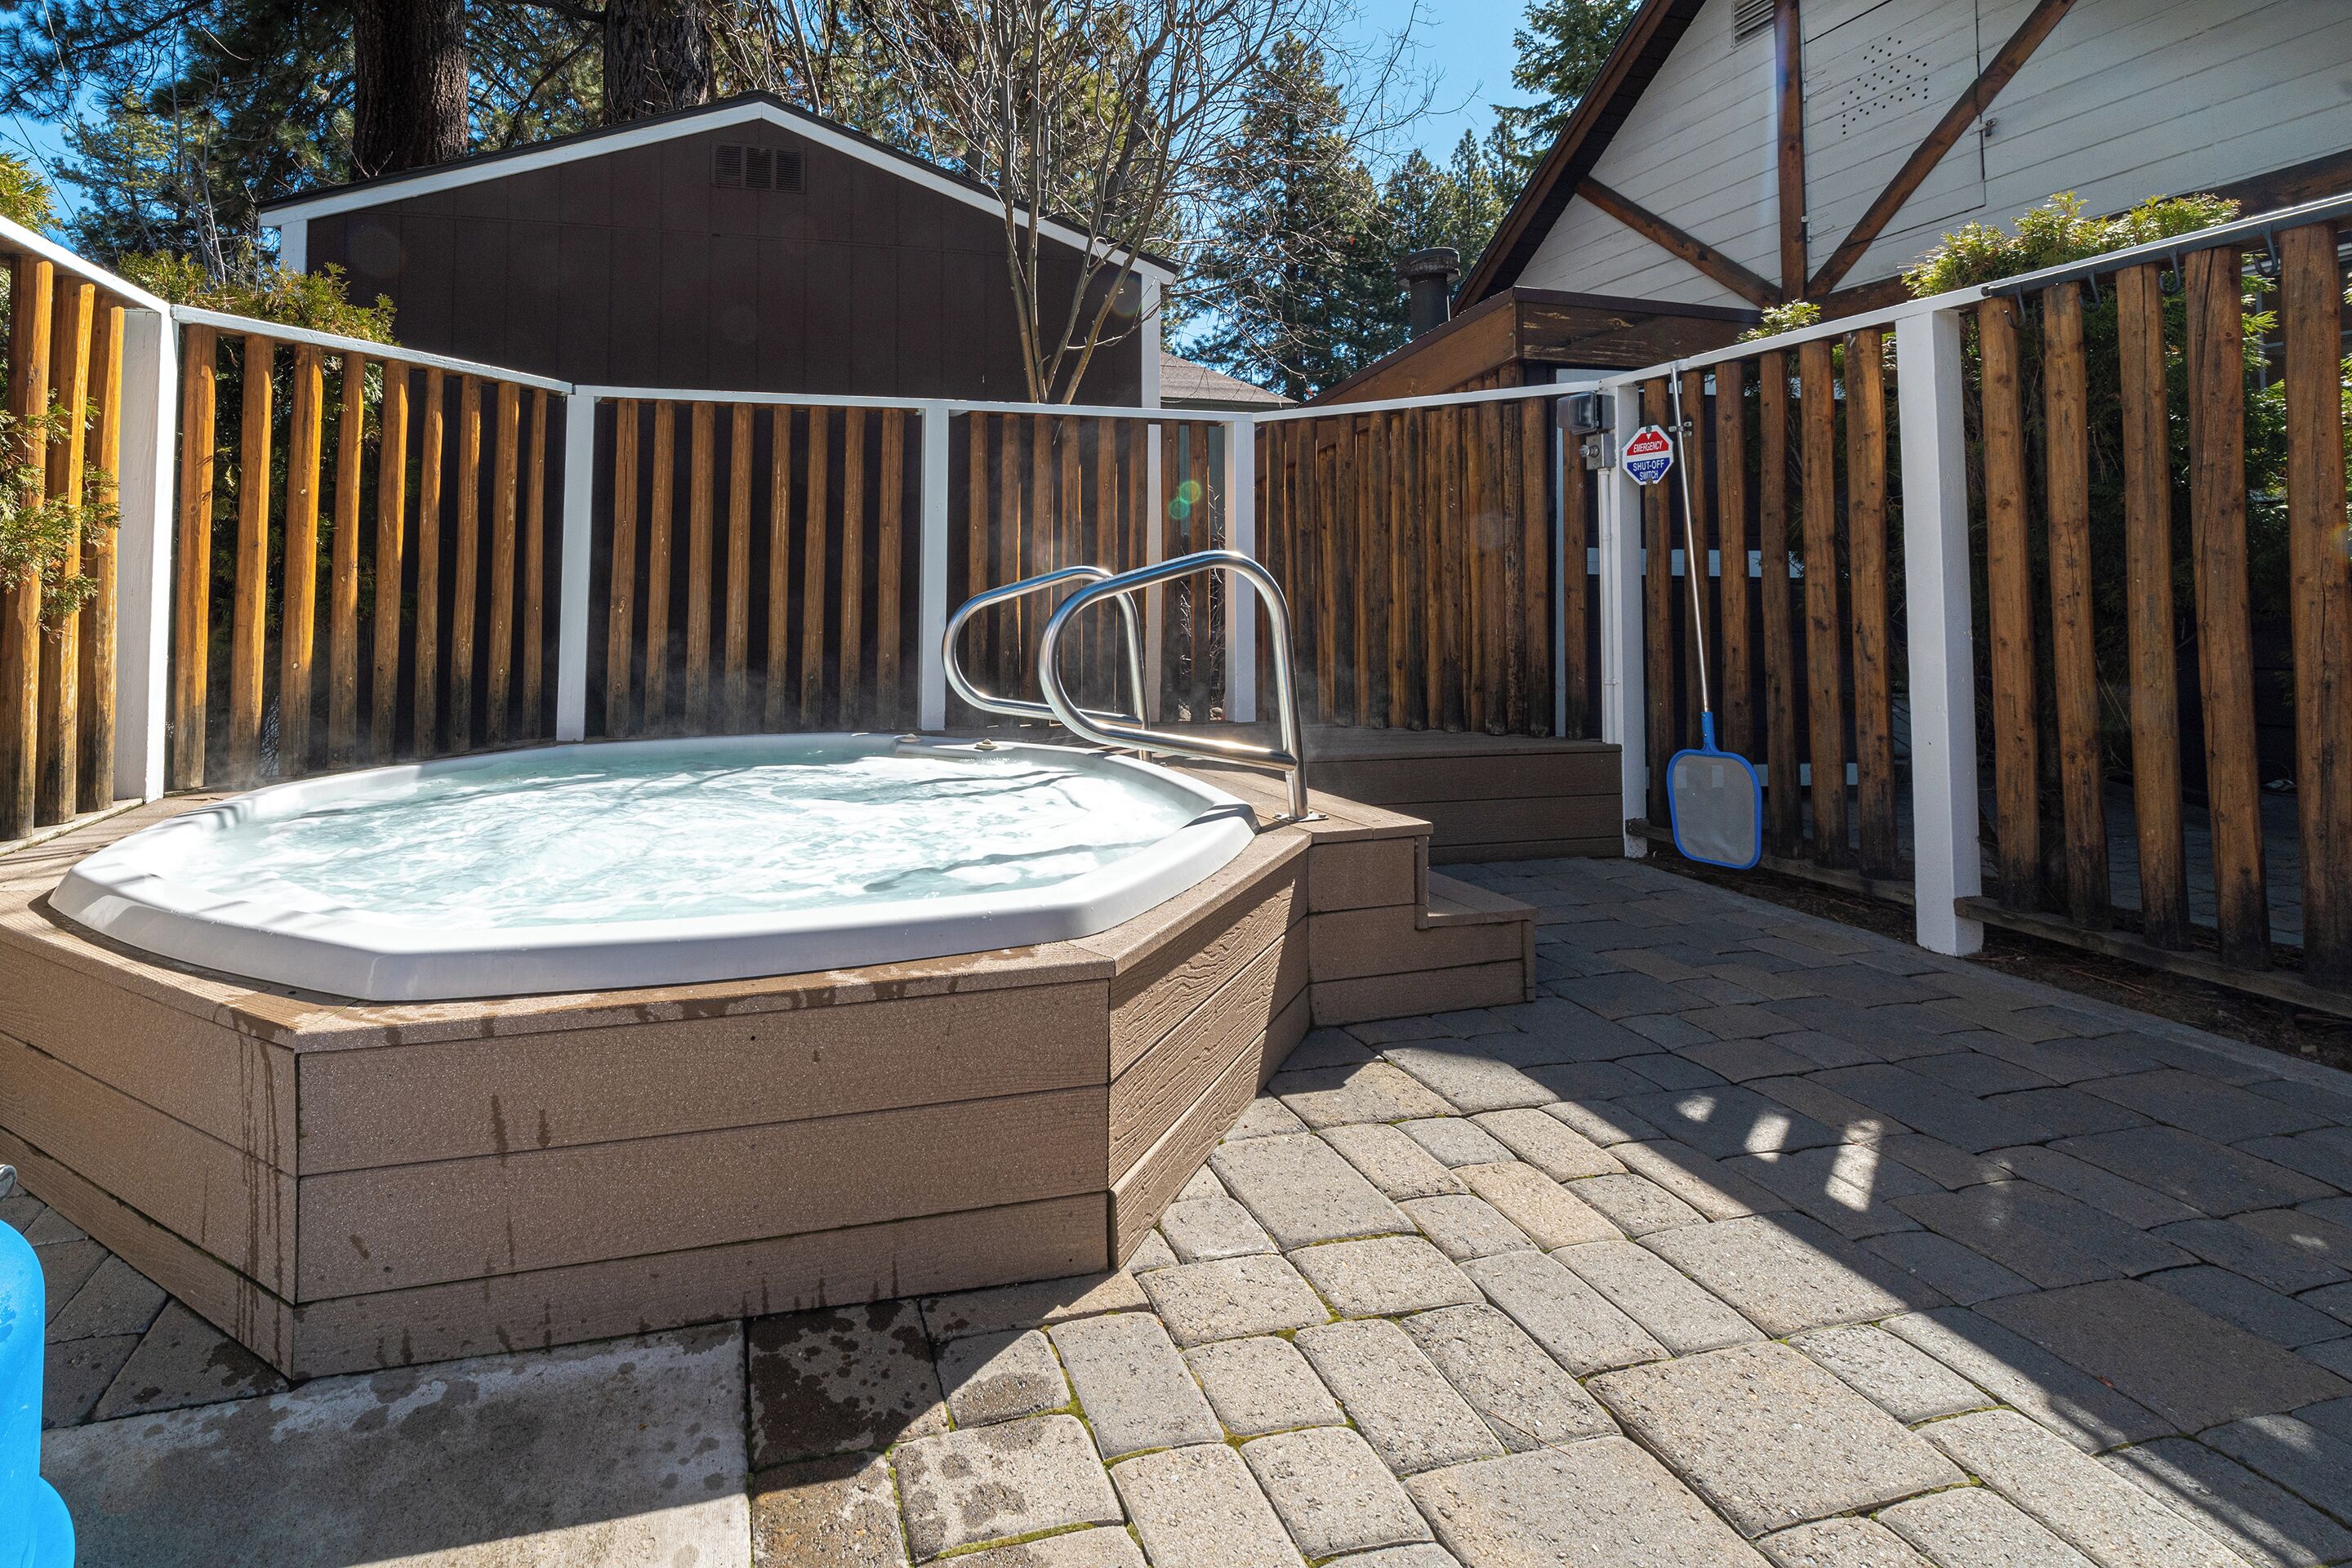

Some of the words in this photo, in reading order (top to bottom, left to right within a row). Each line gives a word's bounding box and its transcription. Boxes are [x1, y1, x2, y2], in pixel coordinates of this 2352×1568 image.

[1633, 441, 1663, 453] EMERGENCY
[1633, 460, 1664, 472] SHUT-OFF
[1639, 470, 1659, 480] SWITCH
